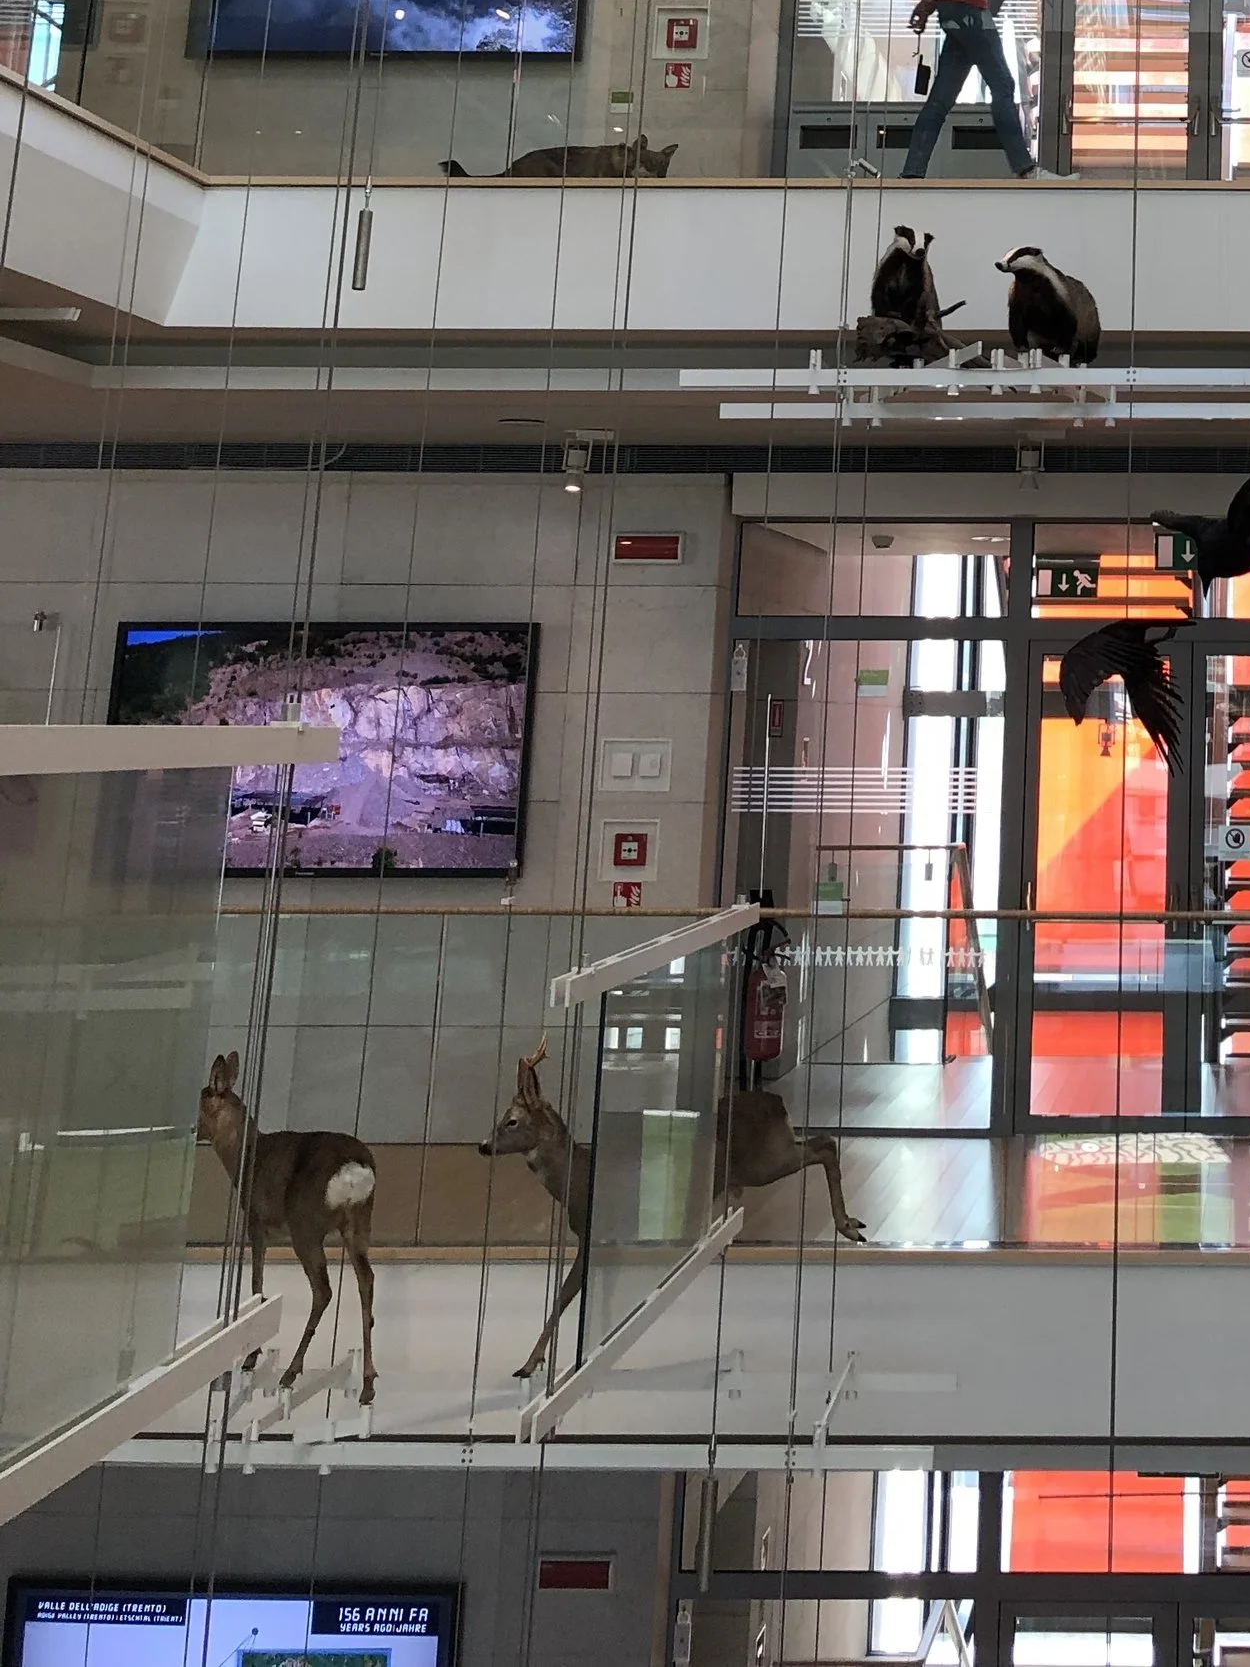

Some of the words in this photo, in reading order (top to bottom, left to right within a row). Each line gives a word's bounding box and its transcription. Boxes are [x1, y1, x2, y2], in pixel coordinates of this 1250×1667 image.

[38, 1601, 66, 1611] VALLE
[69, 1601, 119, 1612] DELL'ADIGE
[122, 1603, 167, 1613] (TRENTO)
[339, 1607, 360, 1622] 156
[365, 1607, 404, 1622] ANNI
[409, 1607, 429, 1622] FA
[340, 1623, 371, 1633] YEARS
